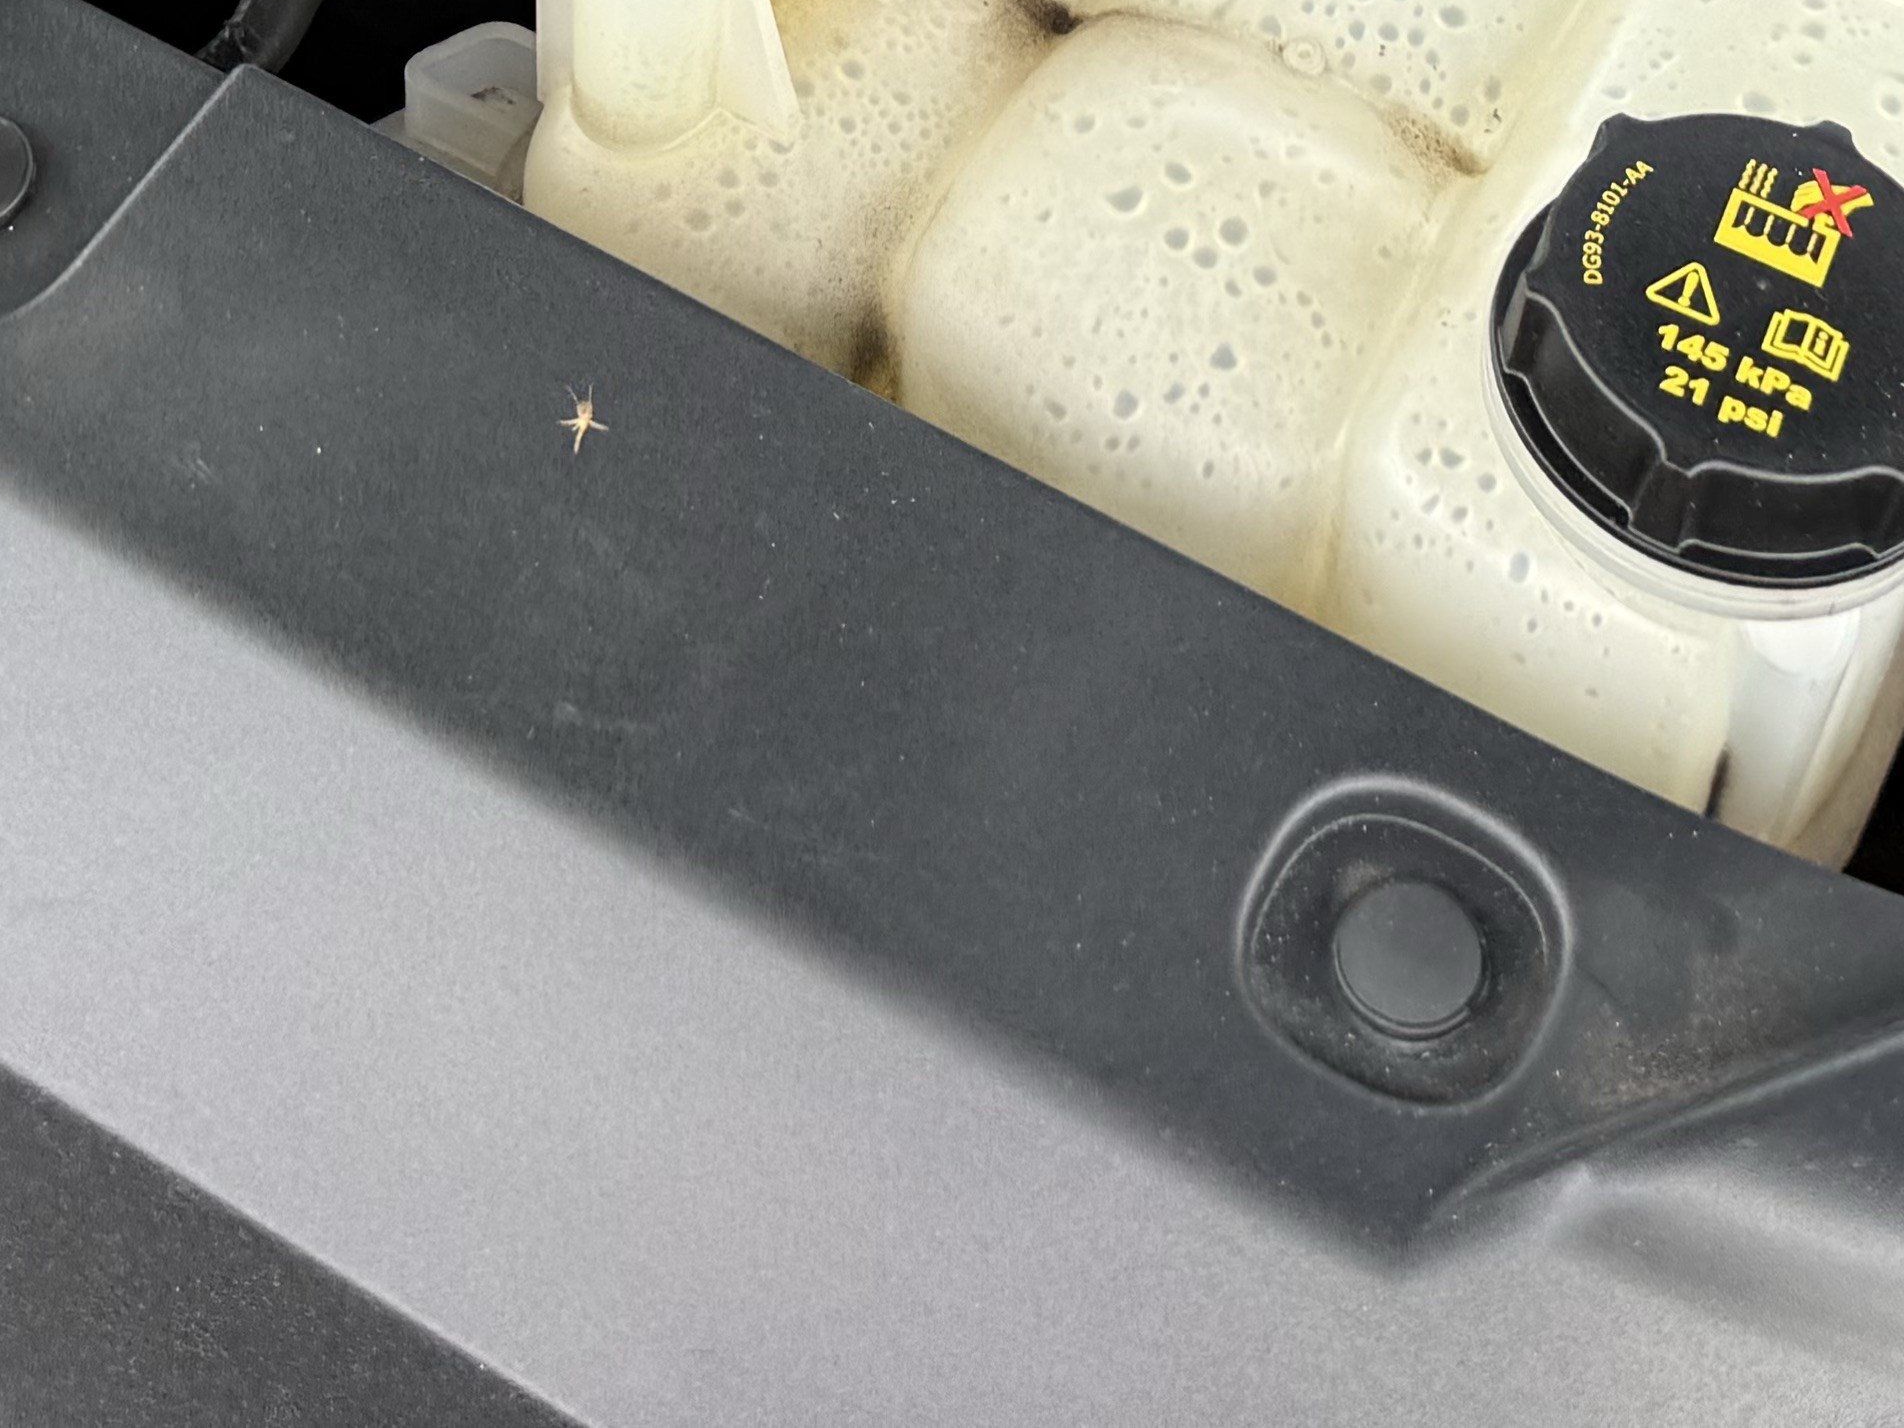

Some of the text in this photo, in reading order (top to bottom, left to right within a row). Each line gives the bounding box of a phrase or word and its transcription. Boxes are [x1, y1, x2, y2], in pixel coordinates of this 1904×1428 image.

[1582, 160, 1654, 285] DG93-8101-AA
[1659, 323, 1813, 411] 145 kPa
[1660, 366, 1783, 438] 21 psi
